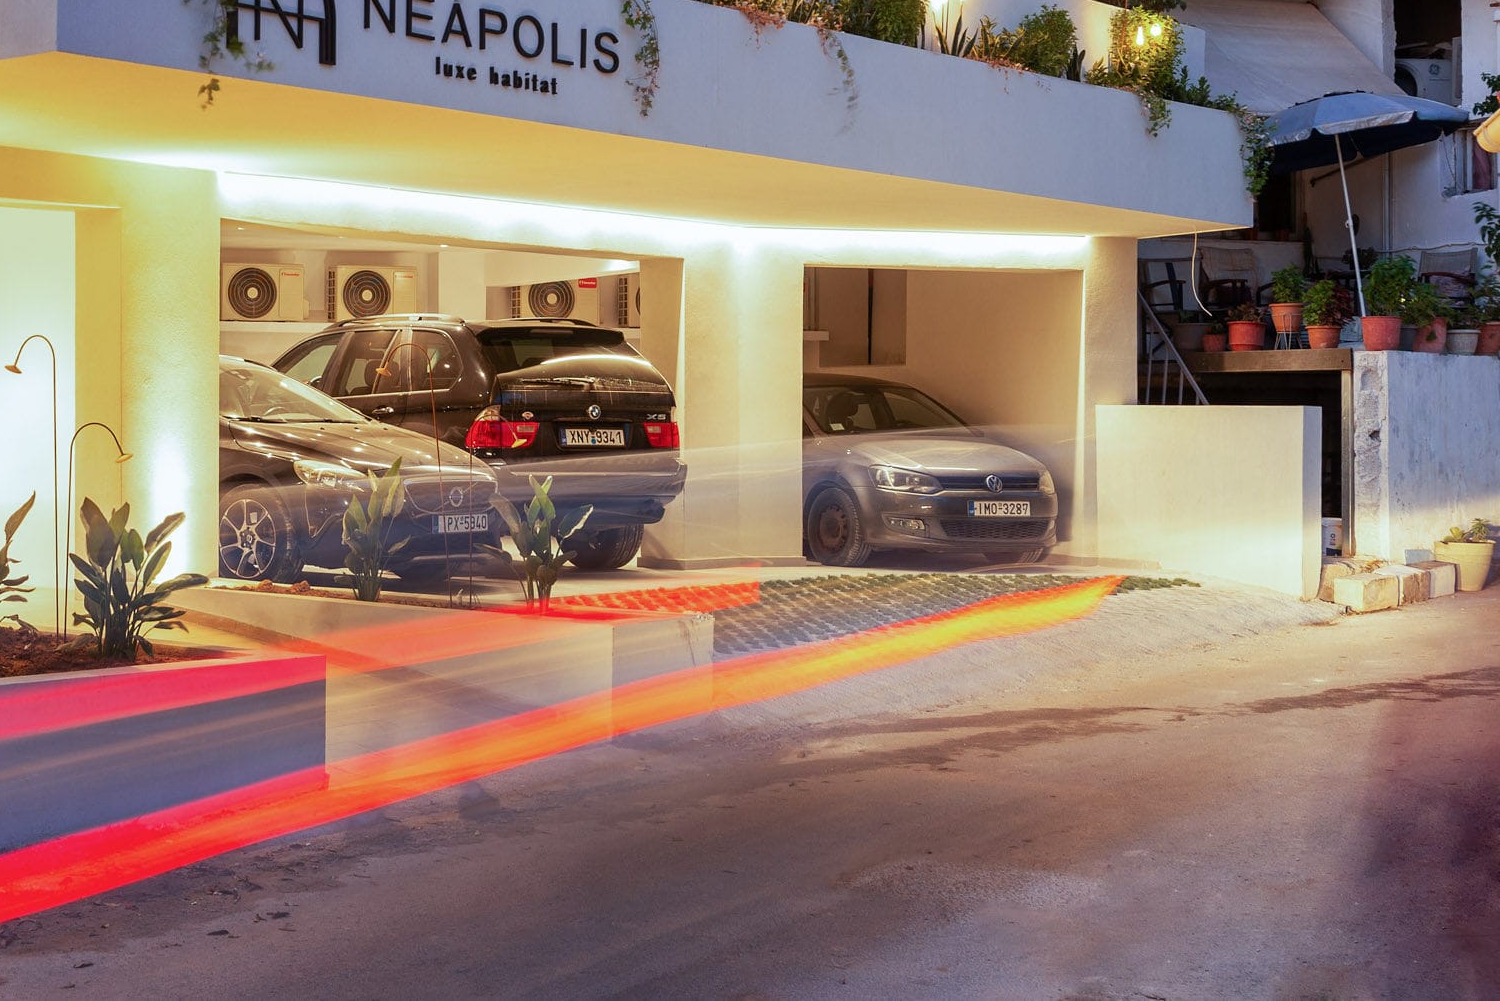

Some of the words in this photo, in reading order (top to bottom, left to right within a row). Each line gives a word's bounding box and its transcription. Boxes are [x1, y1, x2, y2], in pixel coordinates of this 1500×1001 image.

[435, 56, 478, 81] luxe
[489, 65, 559, 96] habitat
[646, 413, 667, 421] X5
